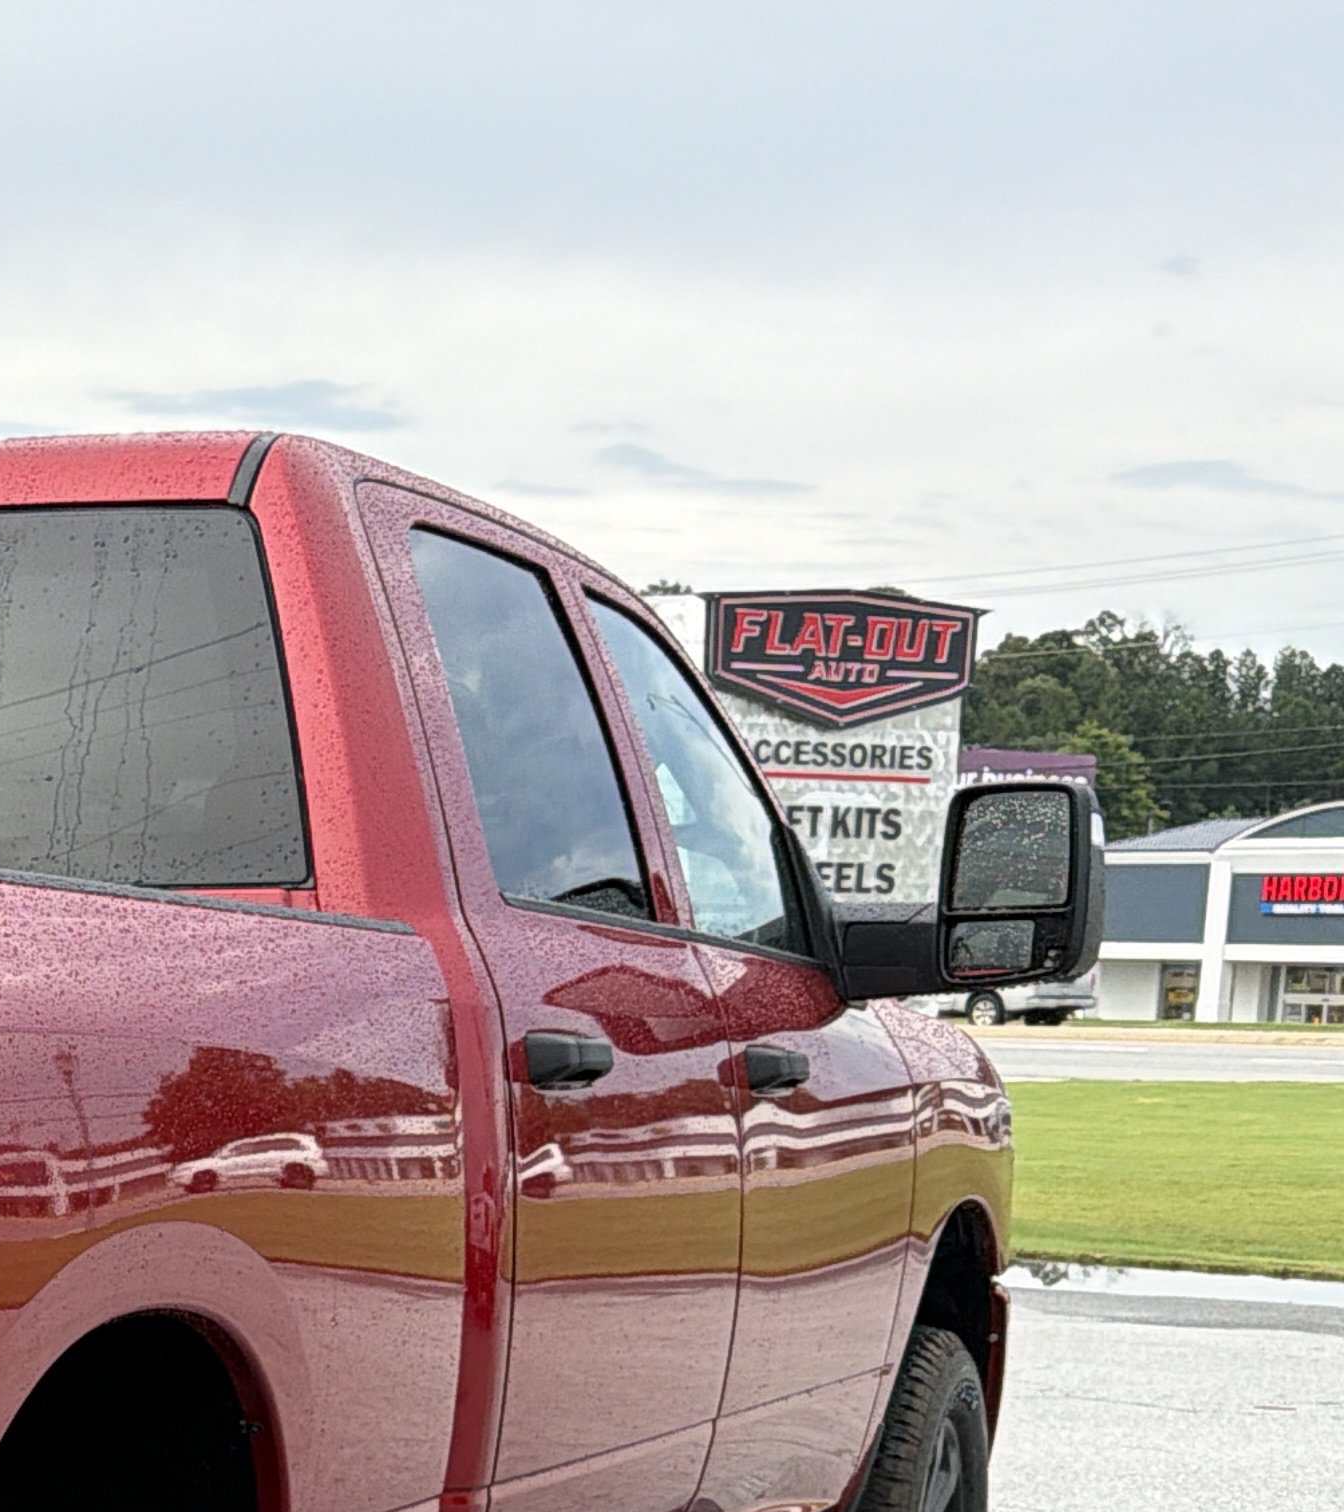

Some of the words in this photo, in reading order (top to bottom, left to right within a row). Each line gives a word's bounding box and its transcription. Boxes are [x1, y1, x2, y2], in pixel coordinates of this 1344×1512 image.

[731, 608, 962, 663] FLAT-OUT
[807, 661, 880, 683] AUTO
[746, 738, 934, 770] CCESSORIES
[831, 806, 902, 840] KITS
